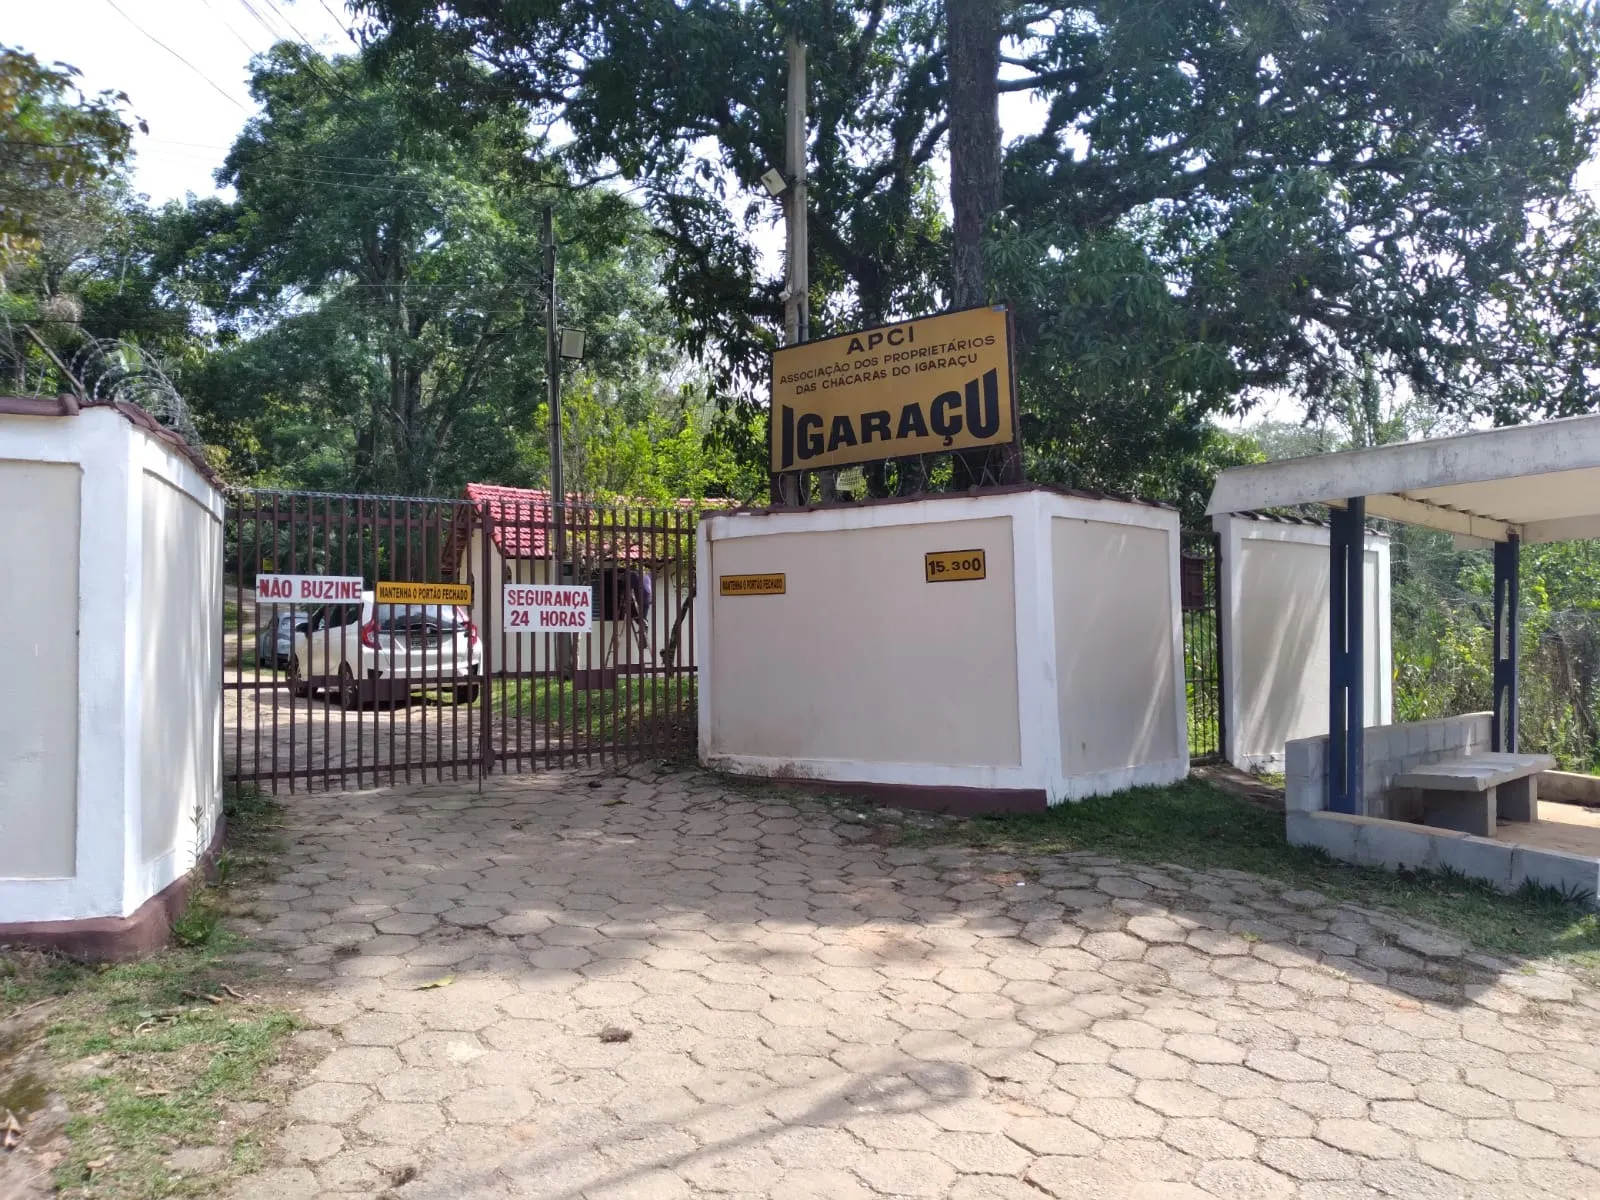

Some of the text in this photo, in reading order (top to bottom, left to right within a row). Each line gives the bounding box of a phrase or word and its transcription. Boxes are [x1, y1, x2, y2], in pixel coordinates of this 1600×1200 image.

[847, 326, 914, 355] APCI
[780, 335, 995, 385] ASSOCIAÇÃO DOS PROPRIETÁRIOS
[796, 353, 977, 395] DAS CHÁCARAS DO IGARAÇU
[782, 368, 999, 469] IGARAÇU
[928, 557, 981, 575] 15.300
[259, 577, 361, 599] NÃO BUZINE
[379, 587, 468, 601] MANTENHA O PORTÃO FECHADO
[508, 589, 589, 609] SEGURANÇA
[510, 610, 586, 627] 24 HORAS
